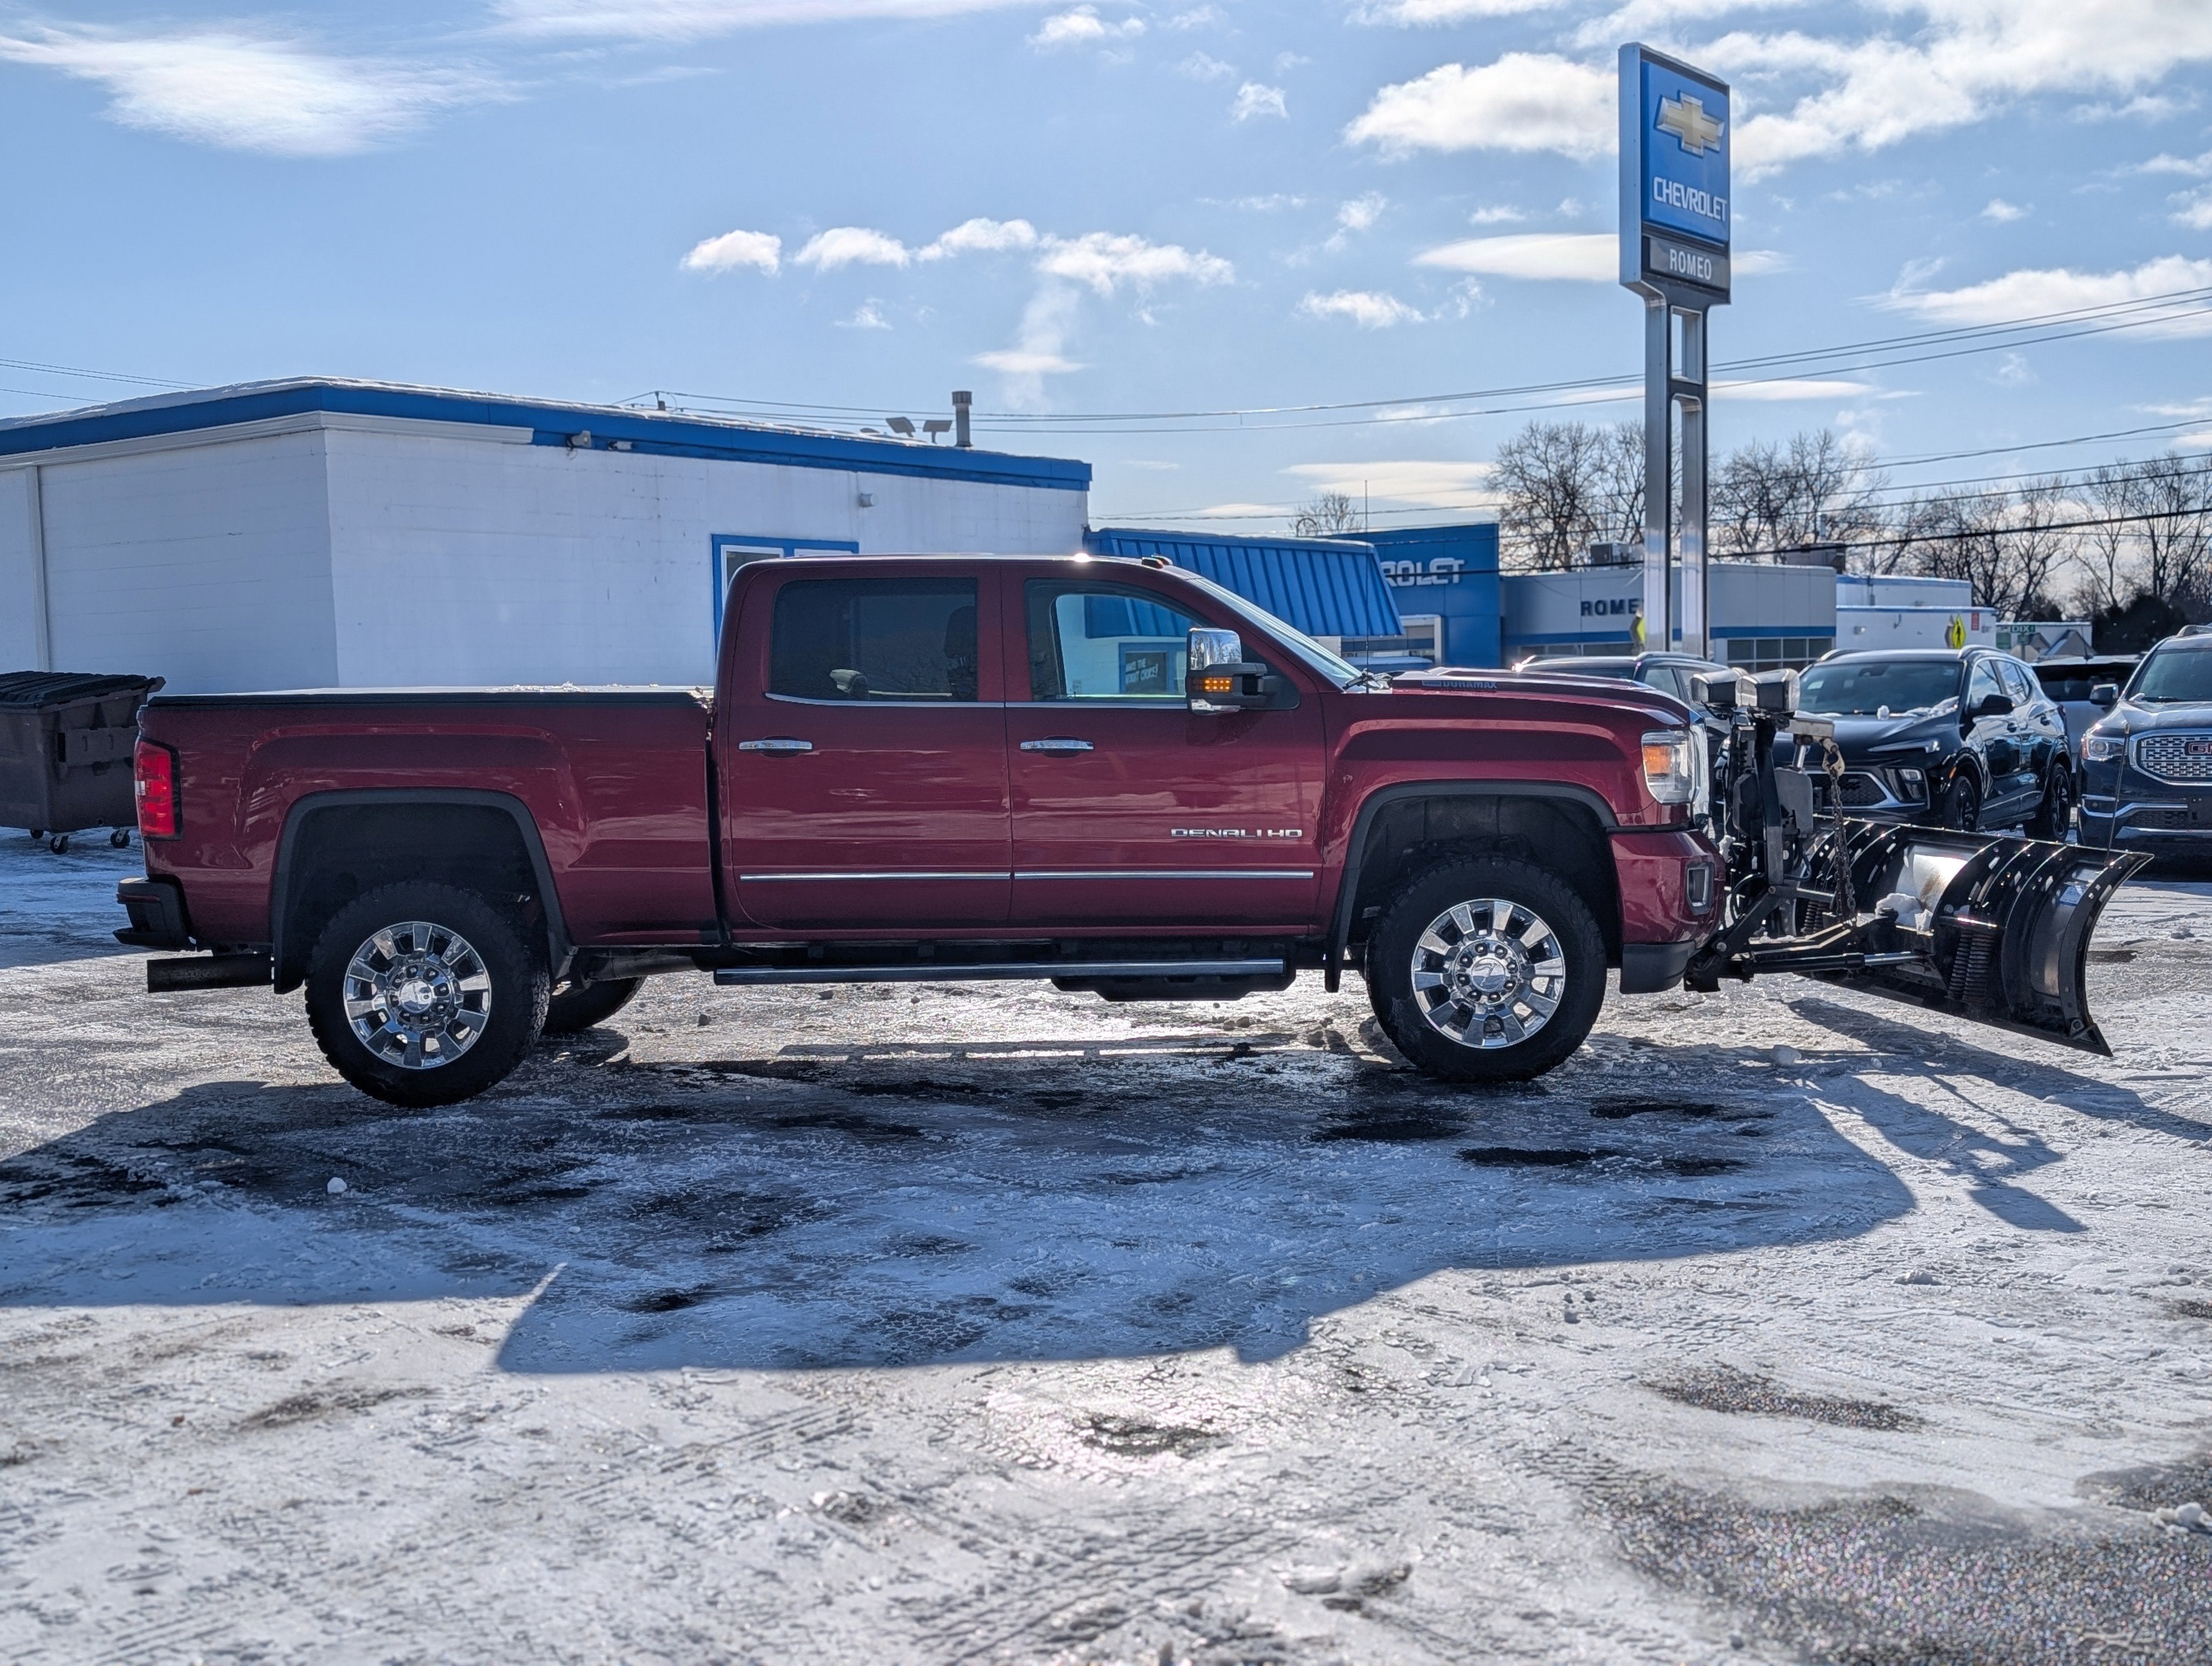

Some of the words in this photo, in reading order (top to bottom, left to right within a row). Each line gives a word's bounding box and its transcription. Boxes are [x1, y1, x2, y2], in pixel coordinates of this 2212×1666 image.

[1654, 176, 1727, 221] CHEVROLET
[1670, 248, 1712, 280] ROMEO
[1580, 598, 1644, 616] ROME
[1443, 681, 1497, 689] DURAMAX
[1171, 829, 1262, 838] DENALI
[1268, 829, 1302, 838] HD
